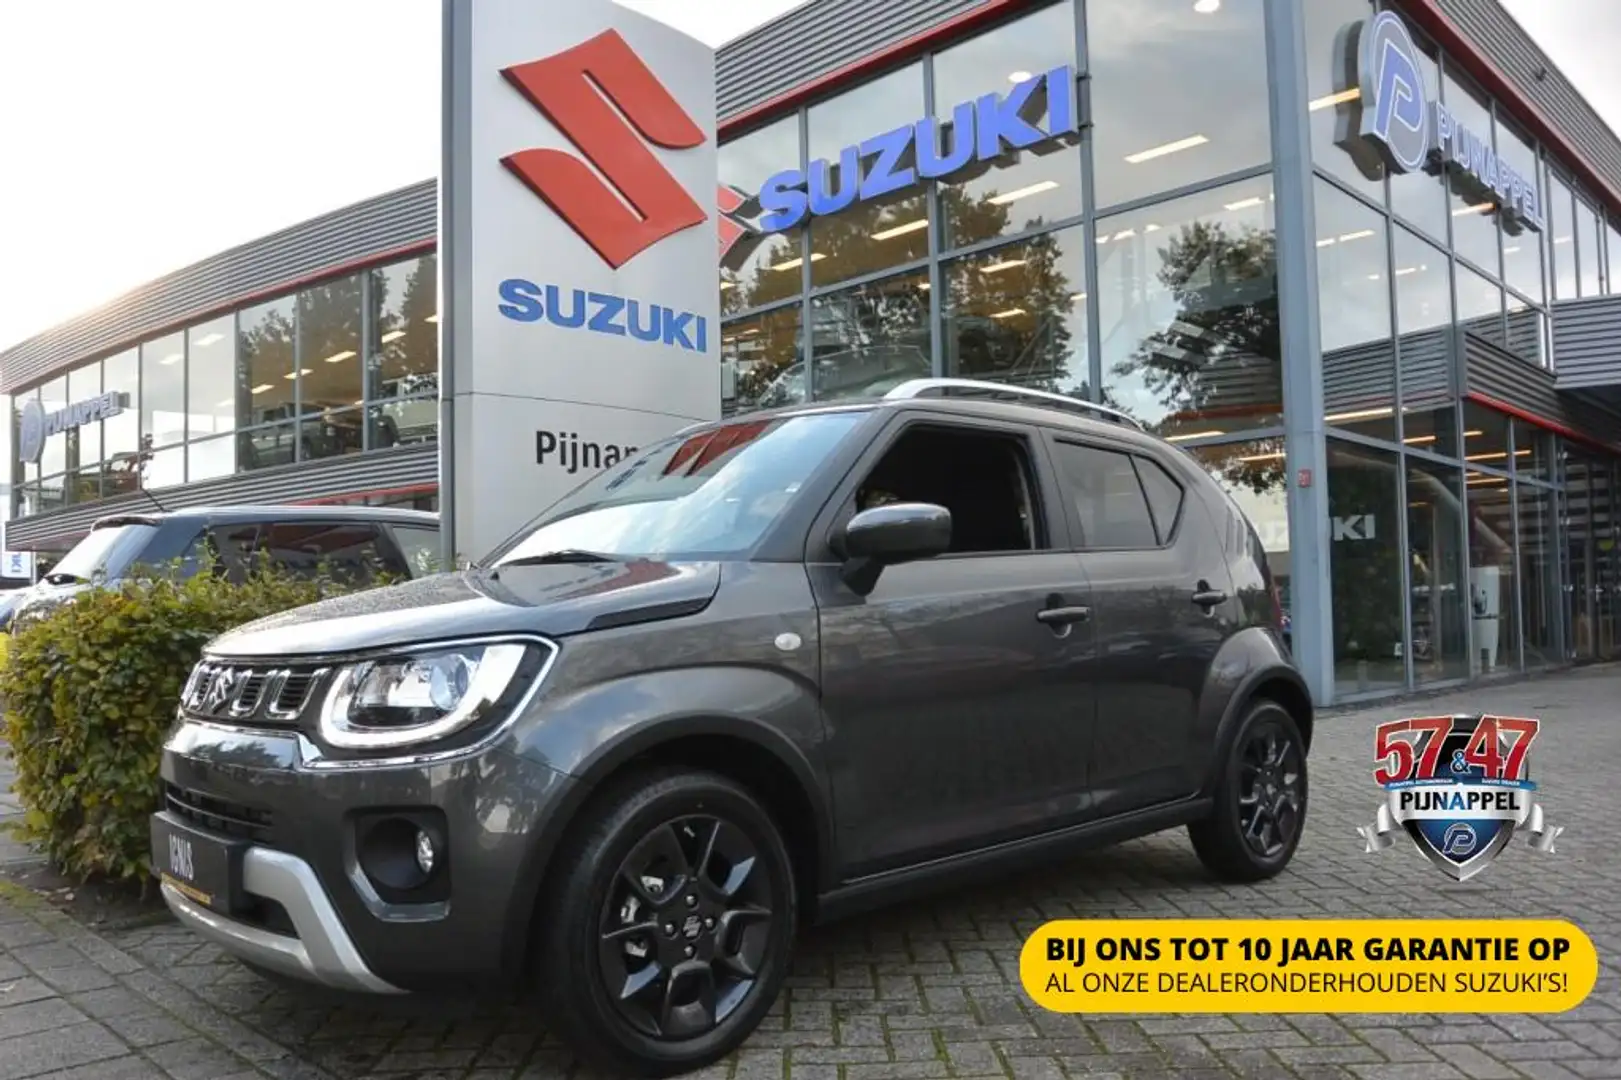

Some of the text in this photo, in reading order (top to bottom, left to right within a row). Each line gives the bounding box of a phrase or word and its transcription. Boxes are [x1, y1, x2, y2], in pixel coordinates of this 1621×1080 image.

[759, 64, 1076, 234] SUZUKI
[1436, 101, 1543, 230] PIJNAPPEL
[498, 278, 707, 353] SUZUKI
